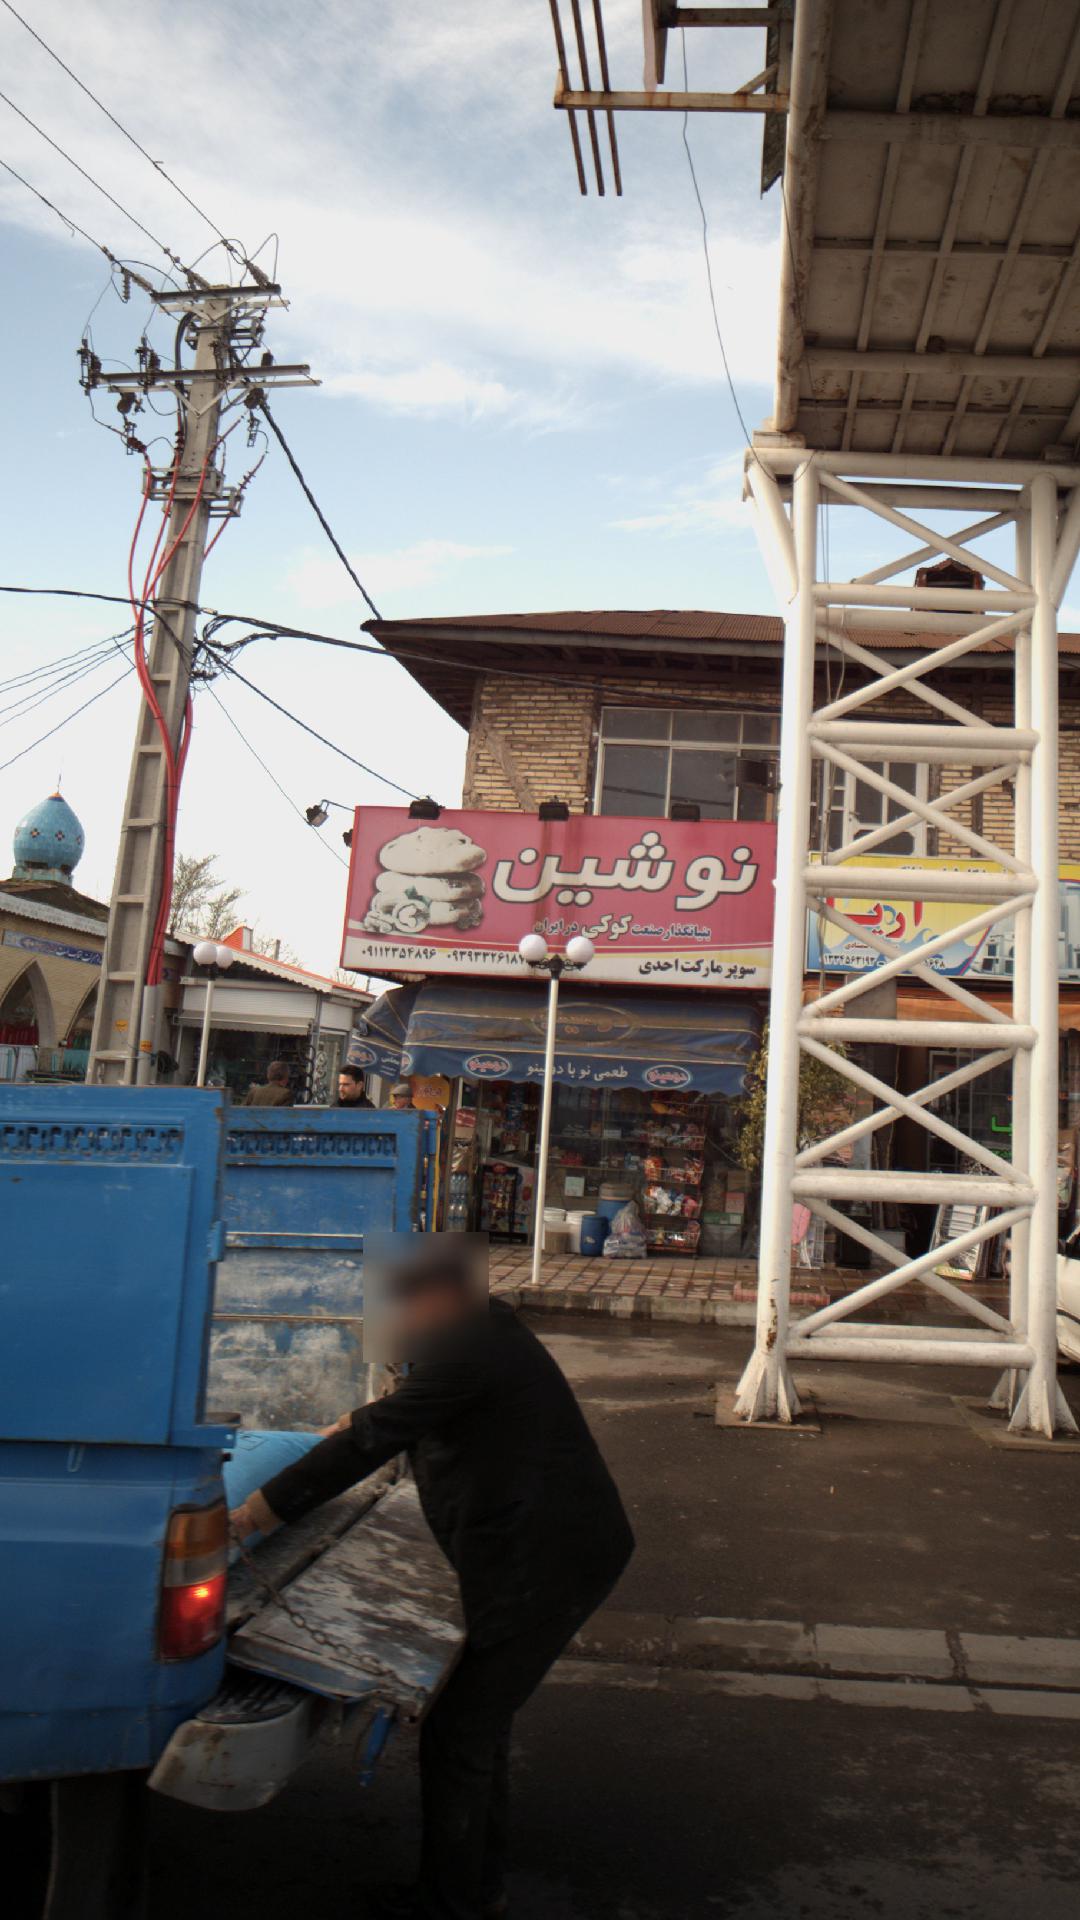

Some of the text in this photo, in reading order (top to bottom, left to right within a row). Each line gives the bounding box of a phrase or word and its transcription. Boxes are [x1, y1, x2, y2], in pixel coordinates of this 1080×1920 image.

[492, 831, 759, 911] نوشین
[533, 918, 563, 935] ایران
[564, 920, 578, 936] در
[581, 913, 633, 941] کوکی
[632, 923, 664, 937] صنعت
[638, 958, 757, 980] سوپر مارکت احدی
[578, 1065, 591, 1080] نو
[648, 1068, 688, 1083] دومینو
